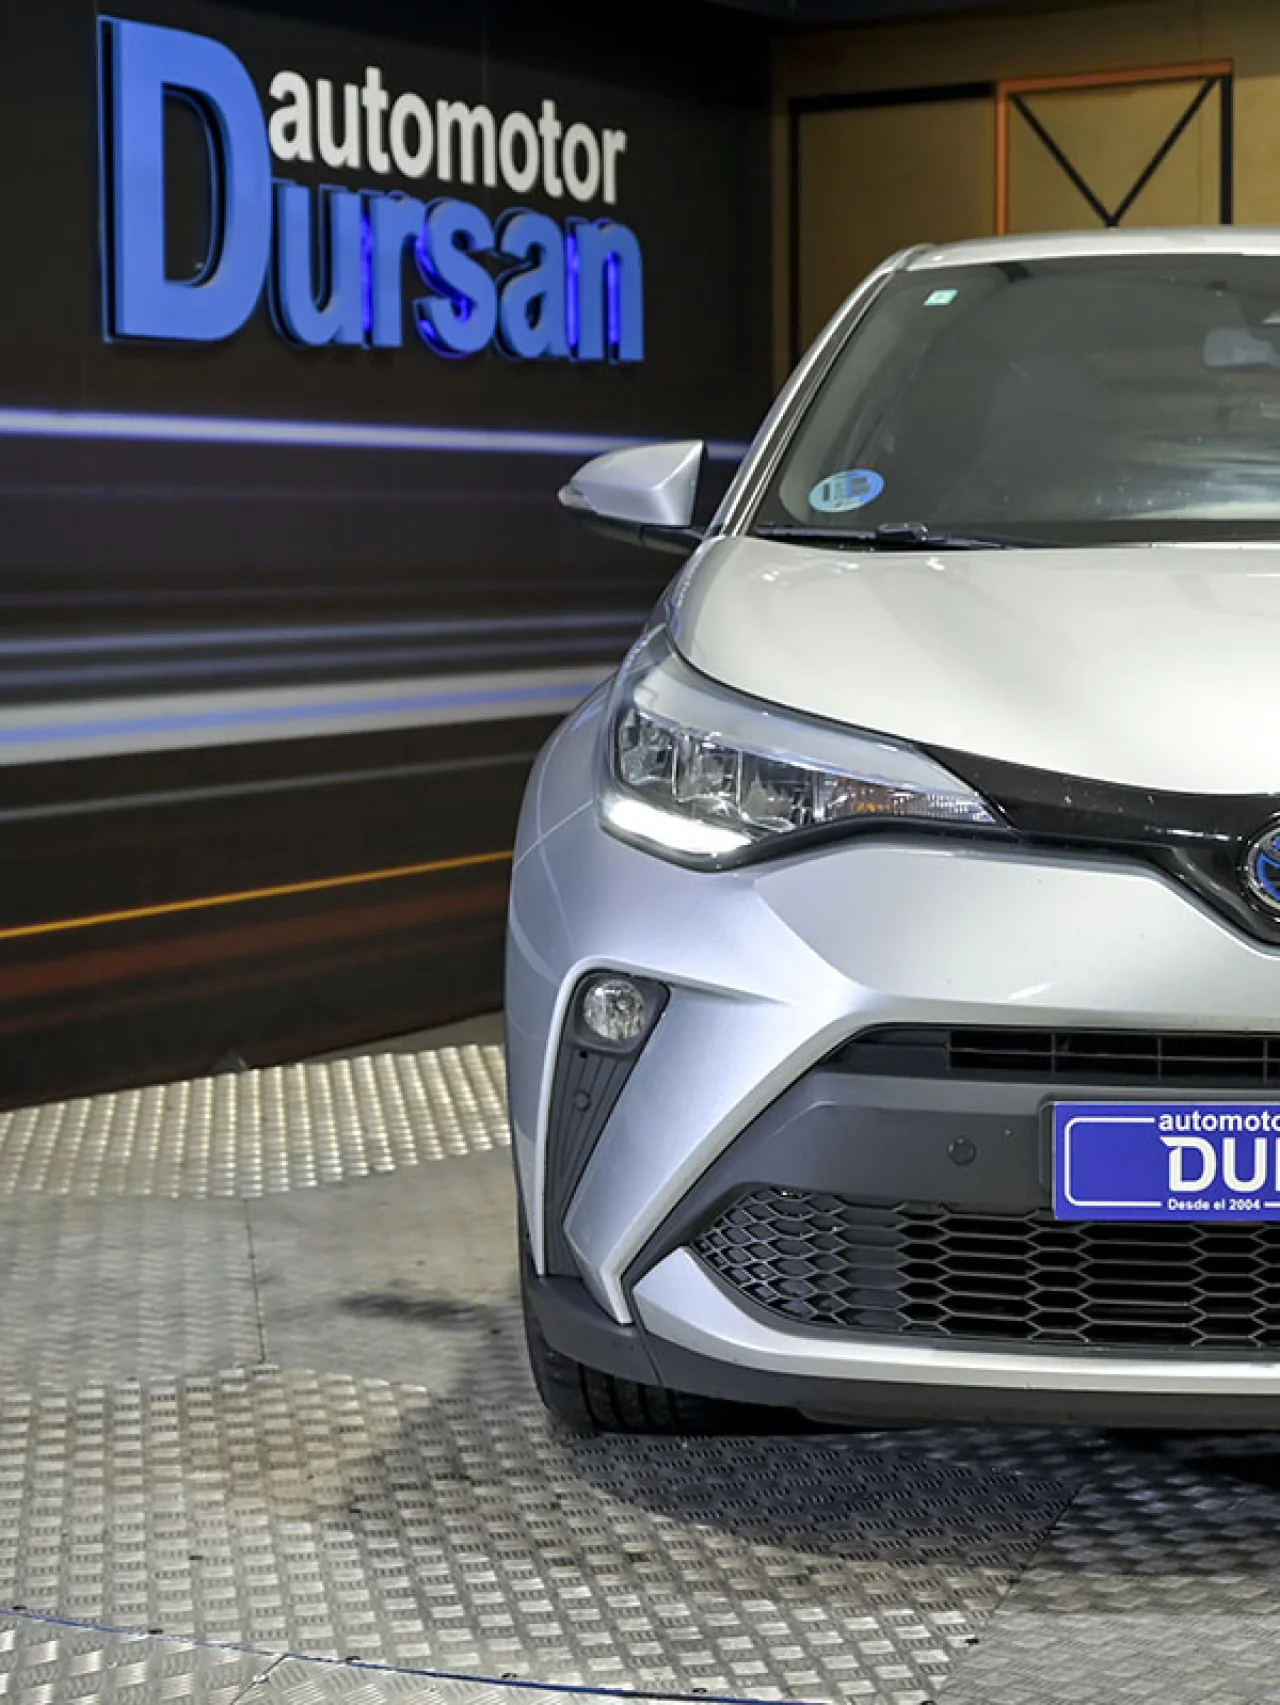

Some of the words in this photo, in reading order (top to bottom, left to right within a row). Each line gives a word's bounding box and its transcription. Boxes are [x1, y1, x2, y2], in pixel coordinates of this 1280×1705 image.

[97, 15, 643, 363] Dursan
[269, 66, 626, 204] automotor
[1168, 1199, 1210, 1211] Desde
[1214, 1199, 1226, 1211] el
[1229, 1199, 1261, 1211] 2004
